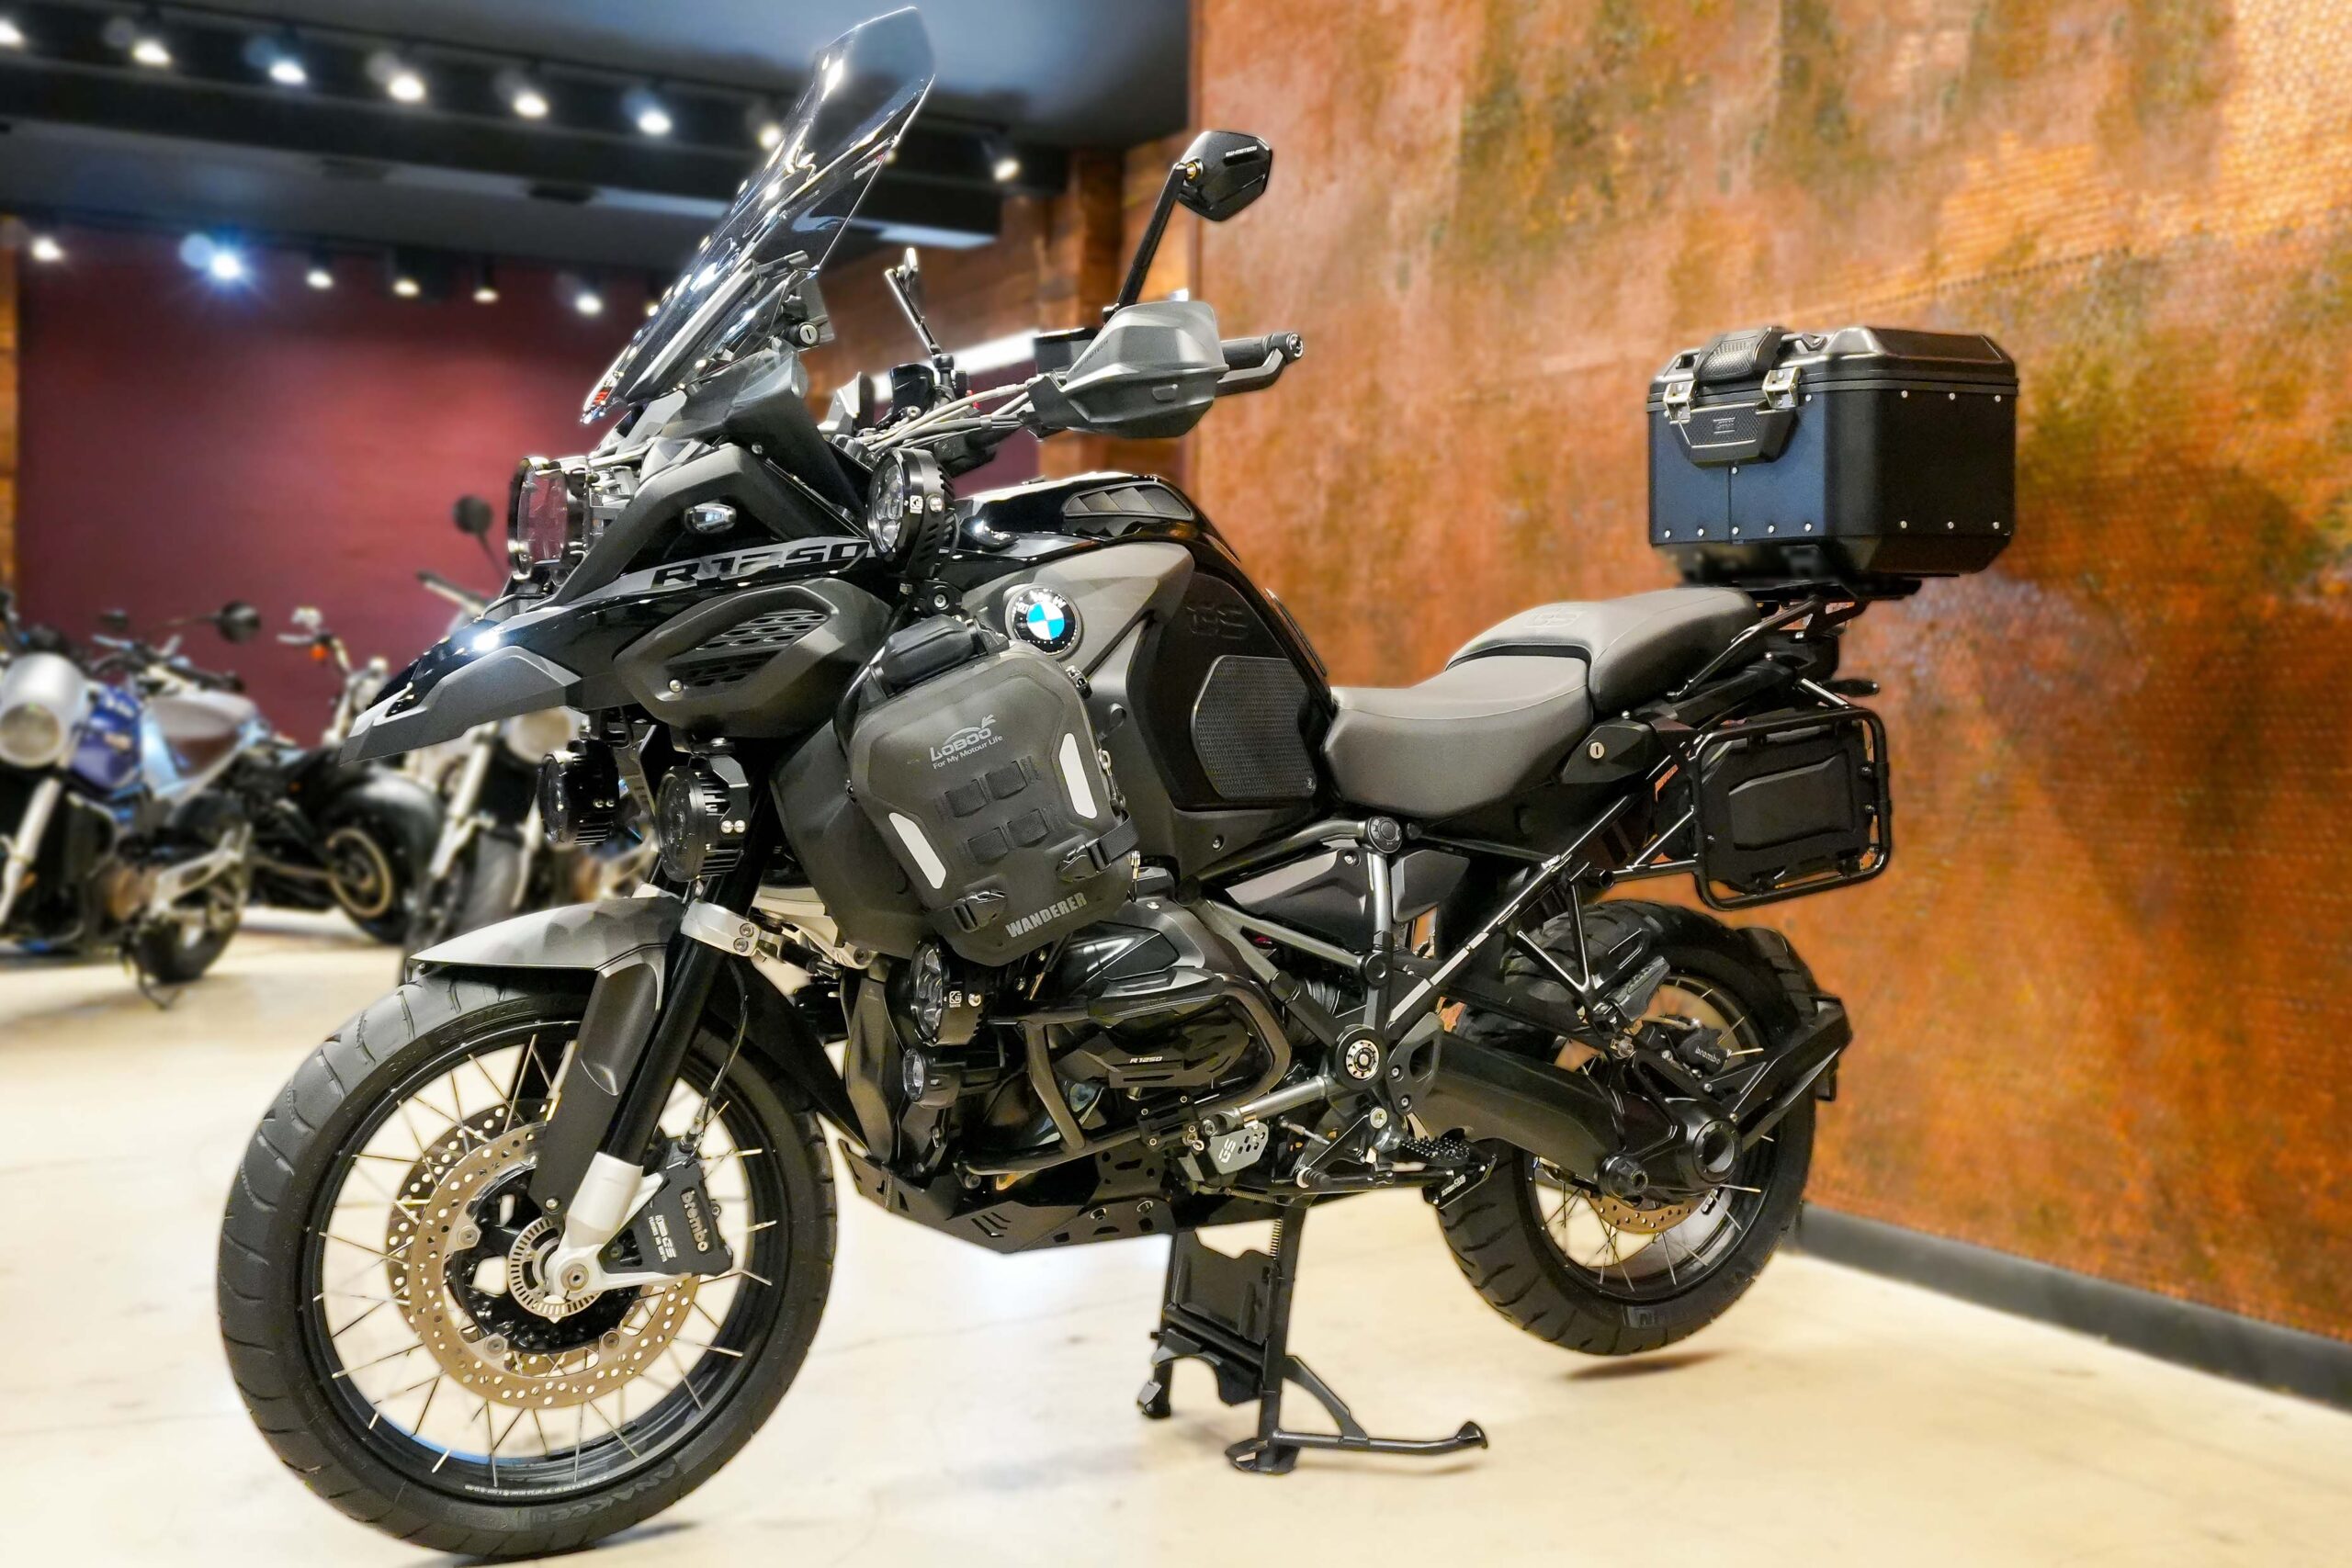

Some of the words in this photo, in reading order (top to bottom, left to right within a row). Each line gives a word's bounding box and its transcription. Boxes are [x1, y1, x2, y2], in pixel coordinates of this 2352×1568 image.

[933, 761, 946, 770] For
[946, 754, 960, 764] My
[959, 742, 988, 759] Motour
[988, 735, 1003, 746] Life
[1005, 892, 1088, 938] WANDERER
[1218, 1137, 1237, 1164] GS
[681, 1190, 708, 1252] brembo
